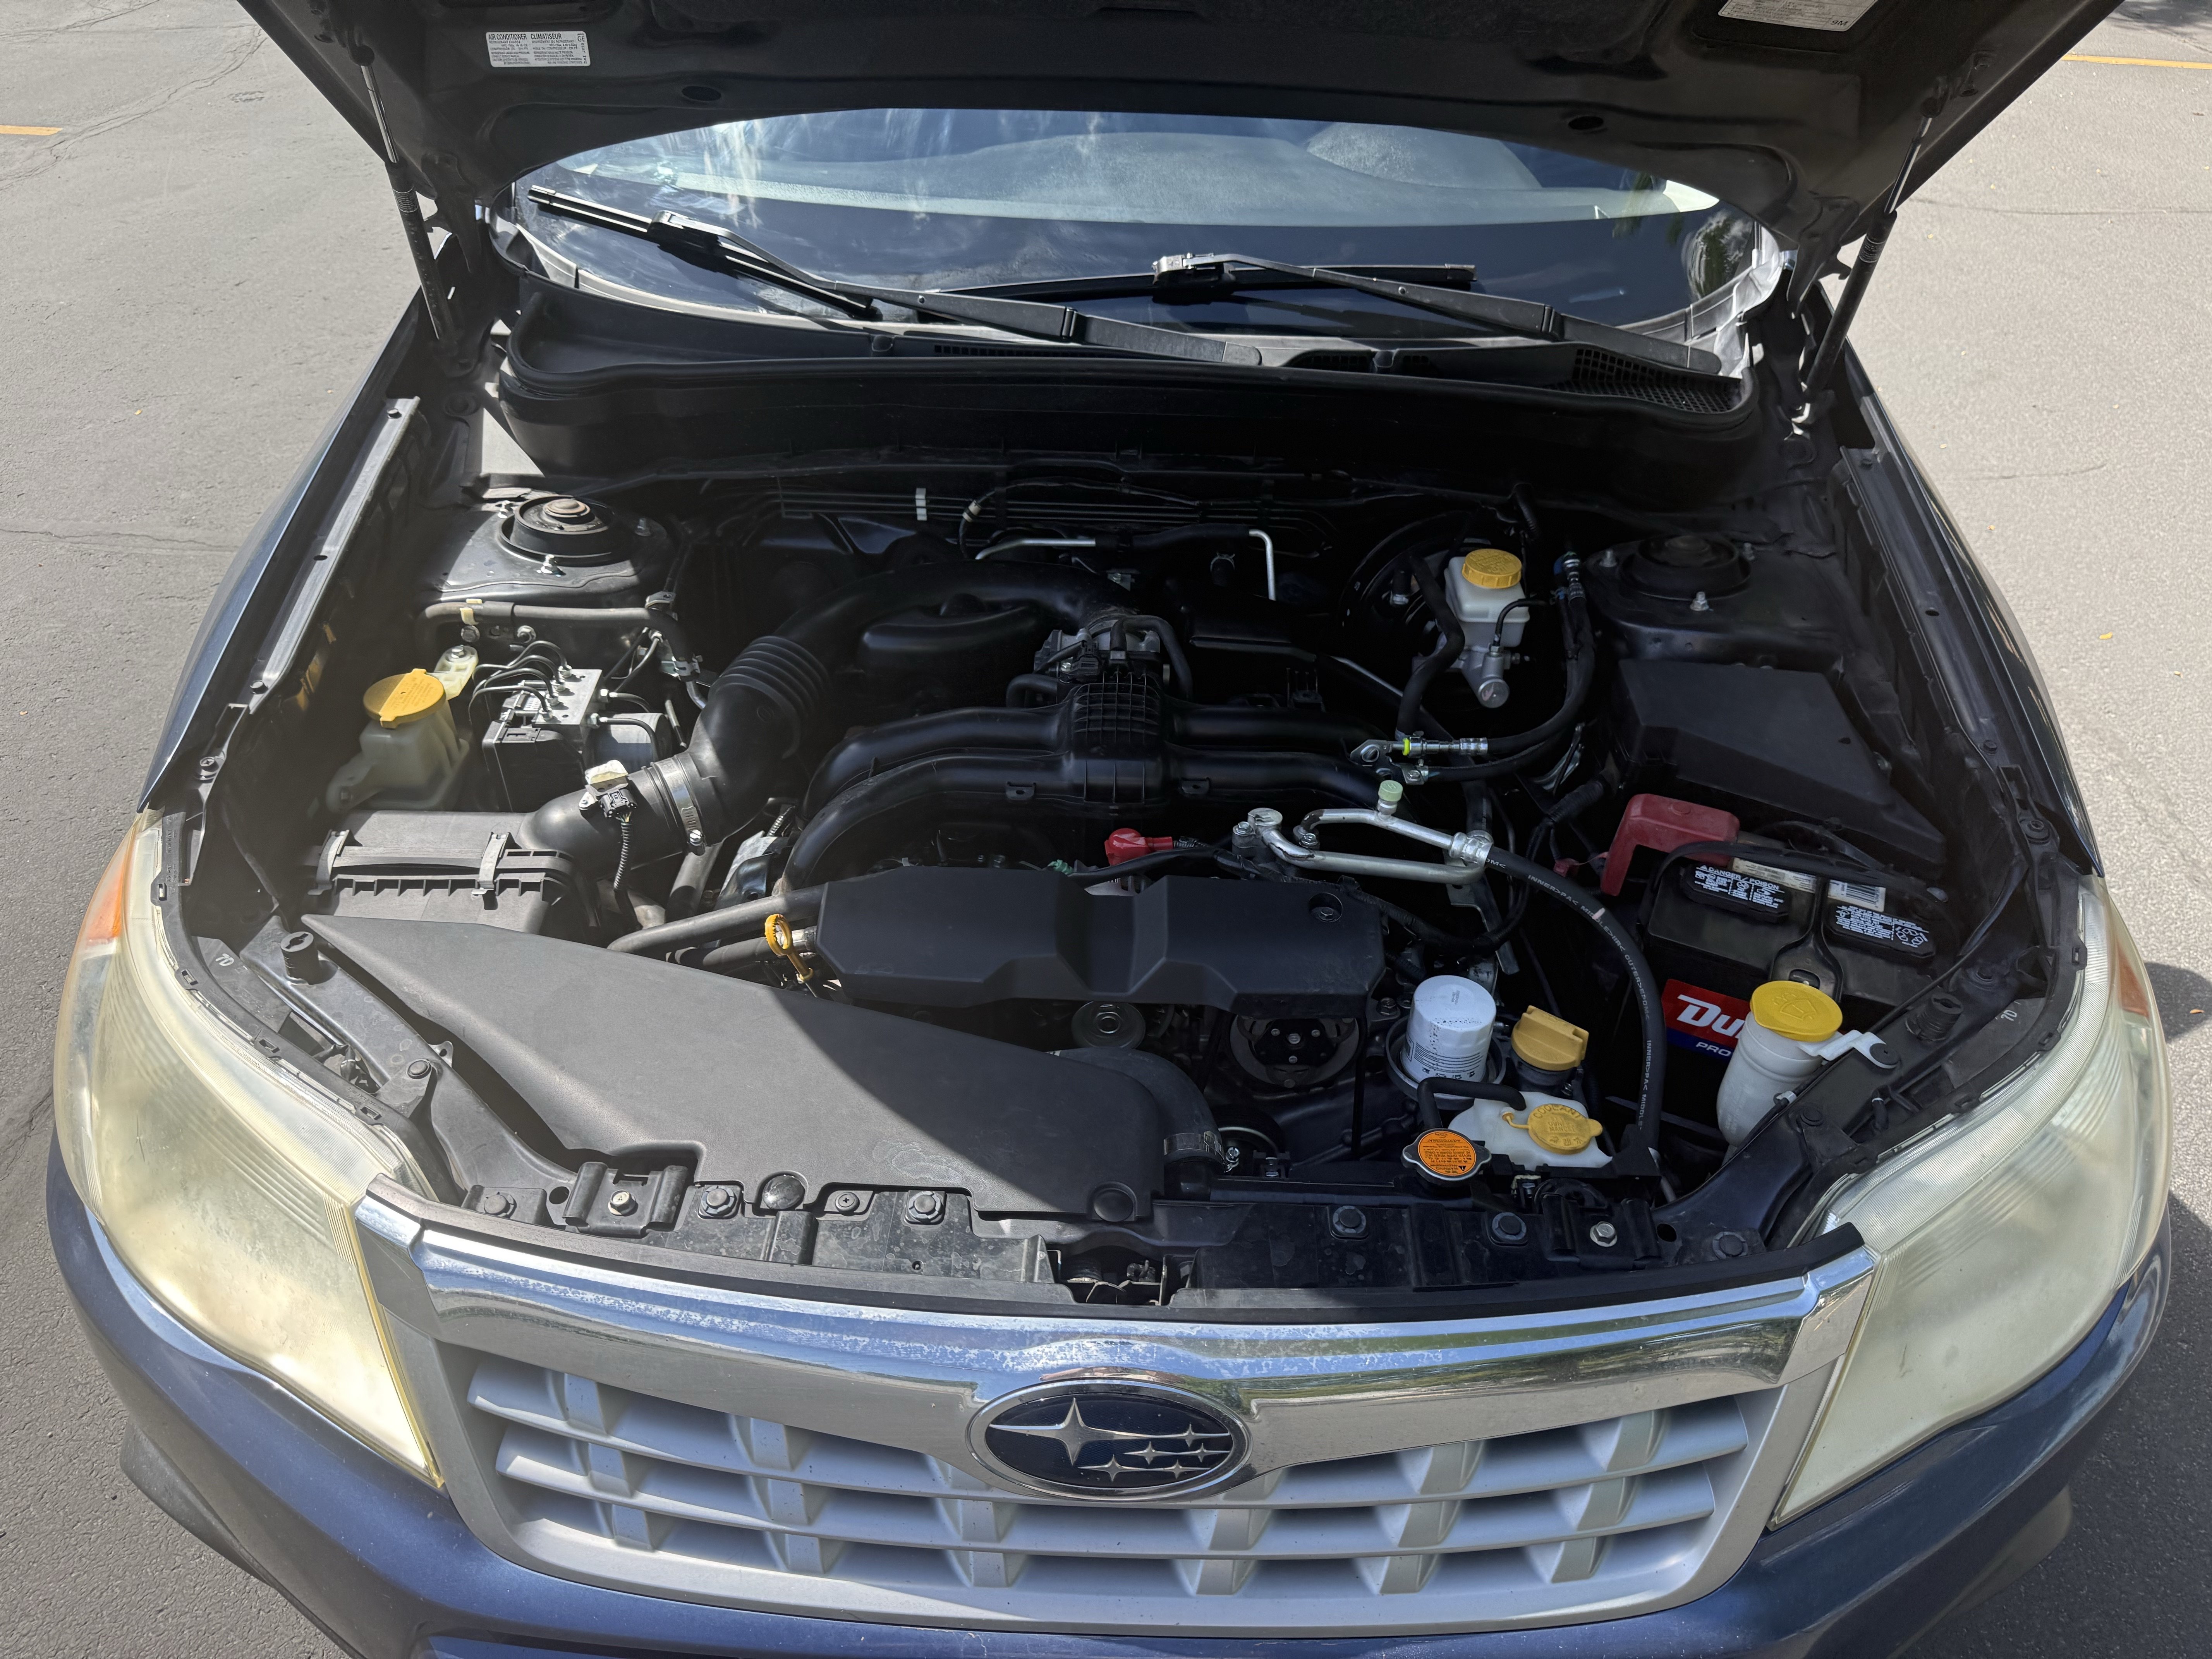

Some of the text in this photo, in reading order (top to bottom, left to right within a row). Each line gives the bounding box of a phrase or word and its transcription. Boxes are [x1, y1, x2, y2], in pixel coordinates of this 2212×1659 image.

[1708, 867, 1741, 879] DANGER
[1749, 878, 1779, 890] POISON
[1676, 994, 1745, 1039] Du
[1533, 1104, 1580, 1118] COOLANT
